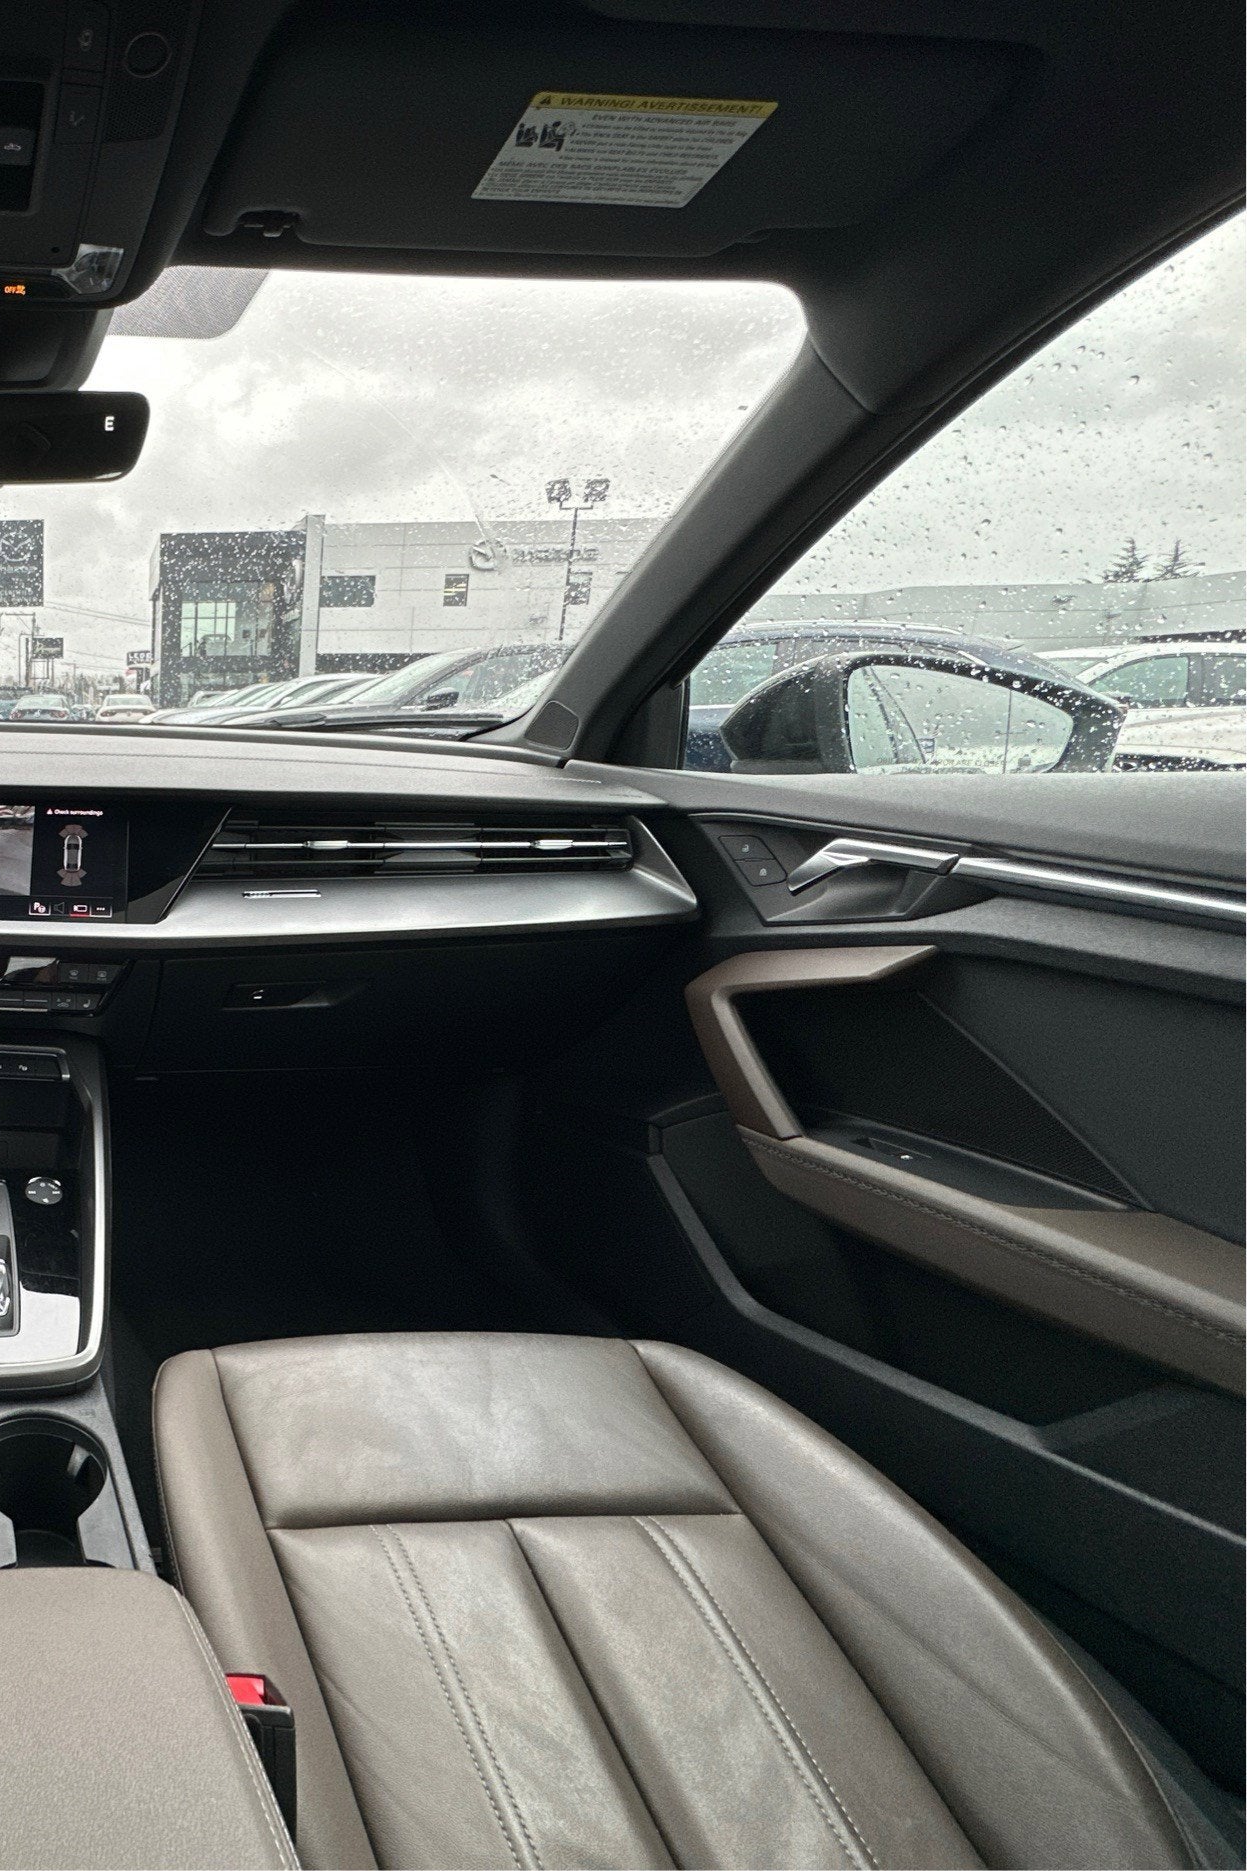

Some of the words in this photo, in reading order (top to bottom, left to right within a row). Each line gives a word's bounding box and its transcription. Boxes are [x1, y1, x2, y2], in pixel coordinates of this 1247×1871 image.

[561, 98, 635, 108] WARNING!
[637, 101, 763, 113] AVERTISSEMENT!
[104, 416, 115, 431] E
[69, 809, 104, 817] surroundings
